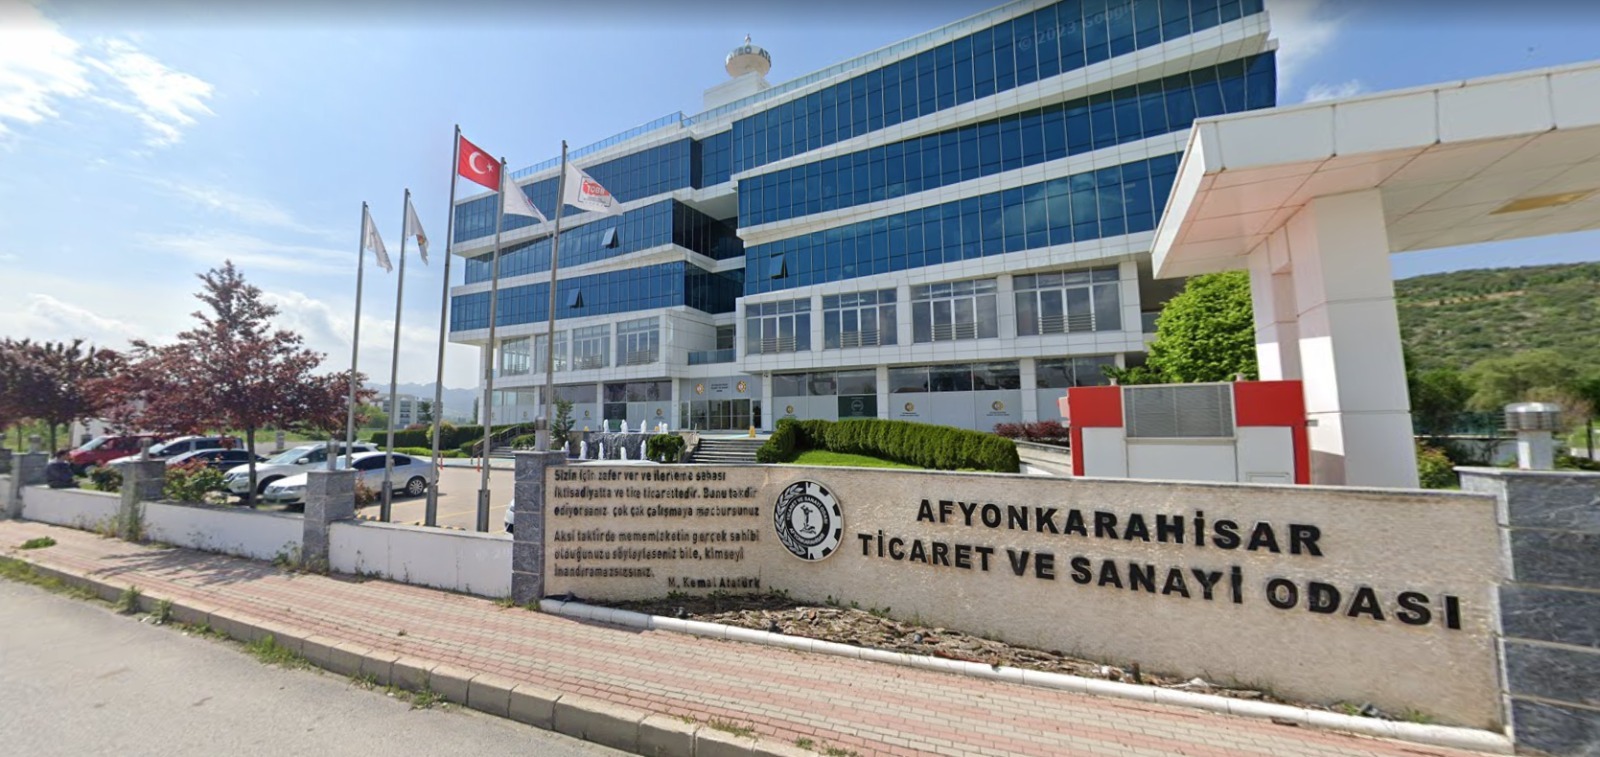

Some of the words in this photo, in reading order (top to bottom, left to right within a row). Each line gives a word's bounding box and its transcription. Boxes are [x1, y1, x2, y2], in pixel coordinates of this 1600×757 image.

[555, 469, 577, 481] Sizin
[598, 469, 622, 481] zafer
[641, 471, 651, 481] ve
[614, 489, 624, 498] ve
[613, 505, 628, 517] çok
[917, 499, 1323, 556] AFYONKARAHİSAR
[554, 530, 575, 541] Aksi
[704, 547, 744, 562] kimseyi
[668, 577, 680, 588] M.
[683, 577, 717, 588] Kemal
[719, 577, 760, 588] Atatürk
[858, 529, 994, 571] TİCARET
[1007, 550, 1055, 580] VE
[1071, 556, 1243, 604] SANAYİ
[1266, 578, 1462, 630] ODASI
